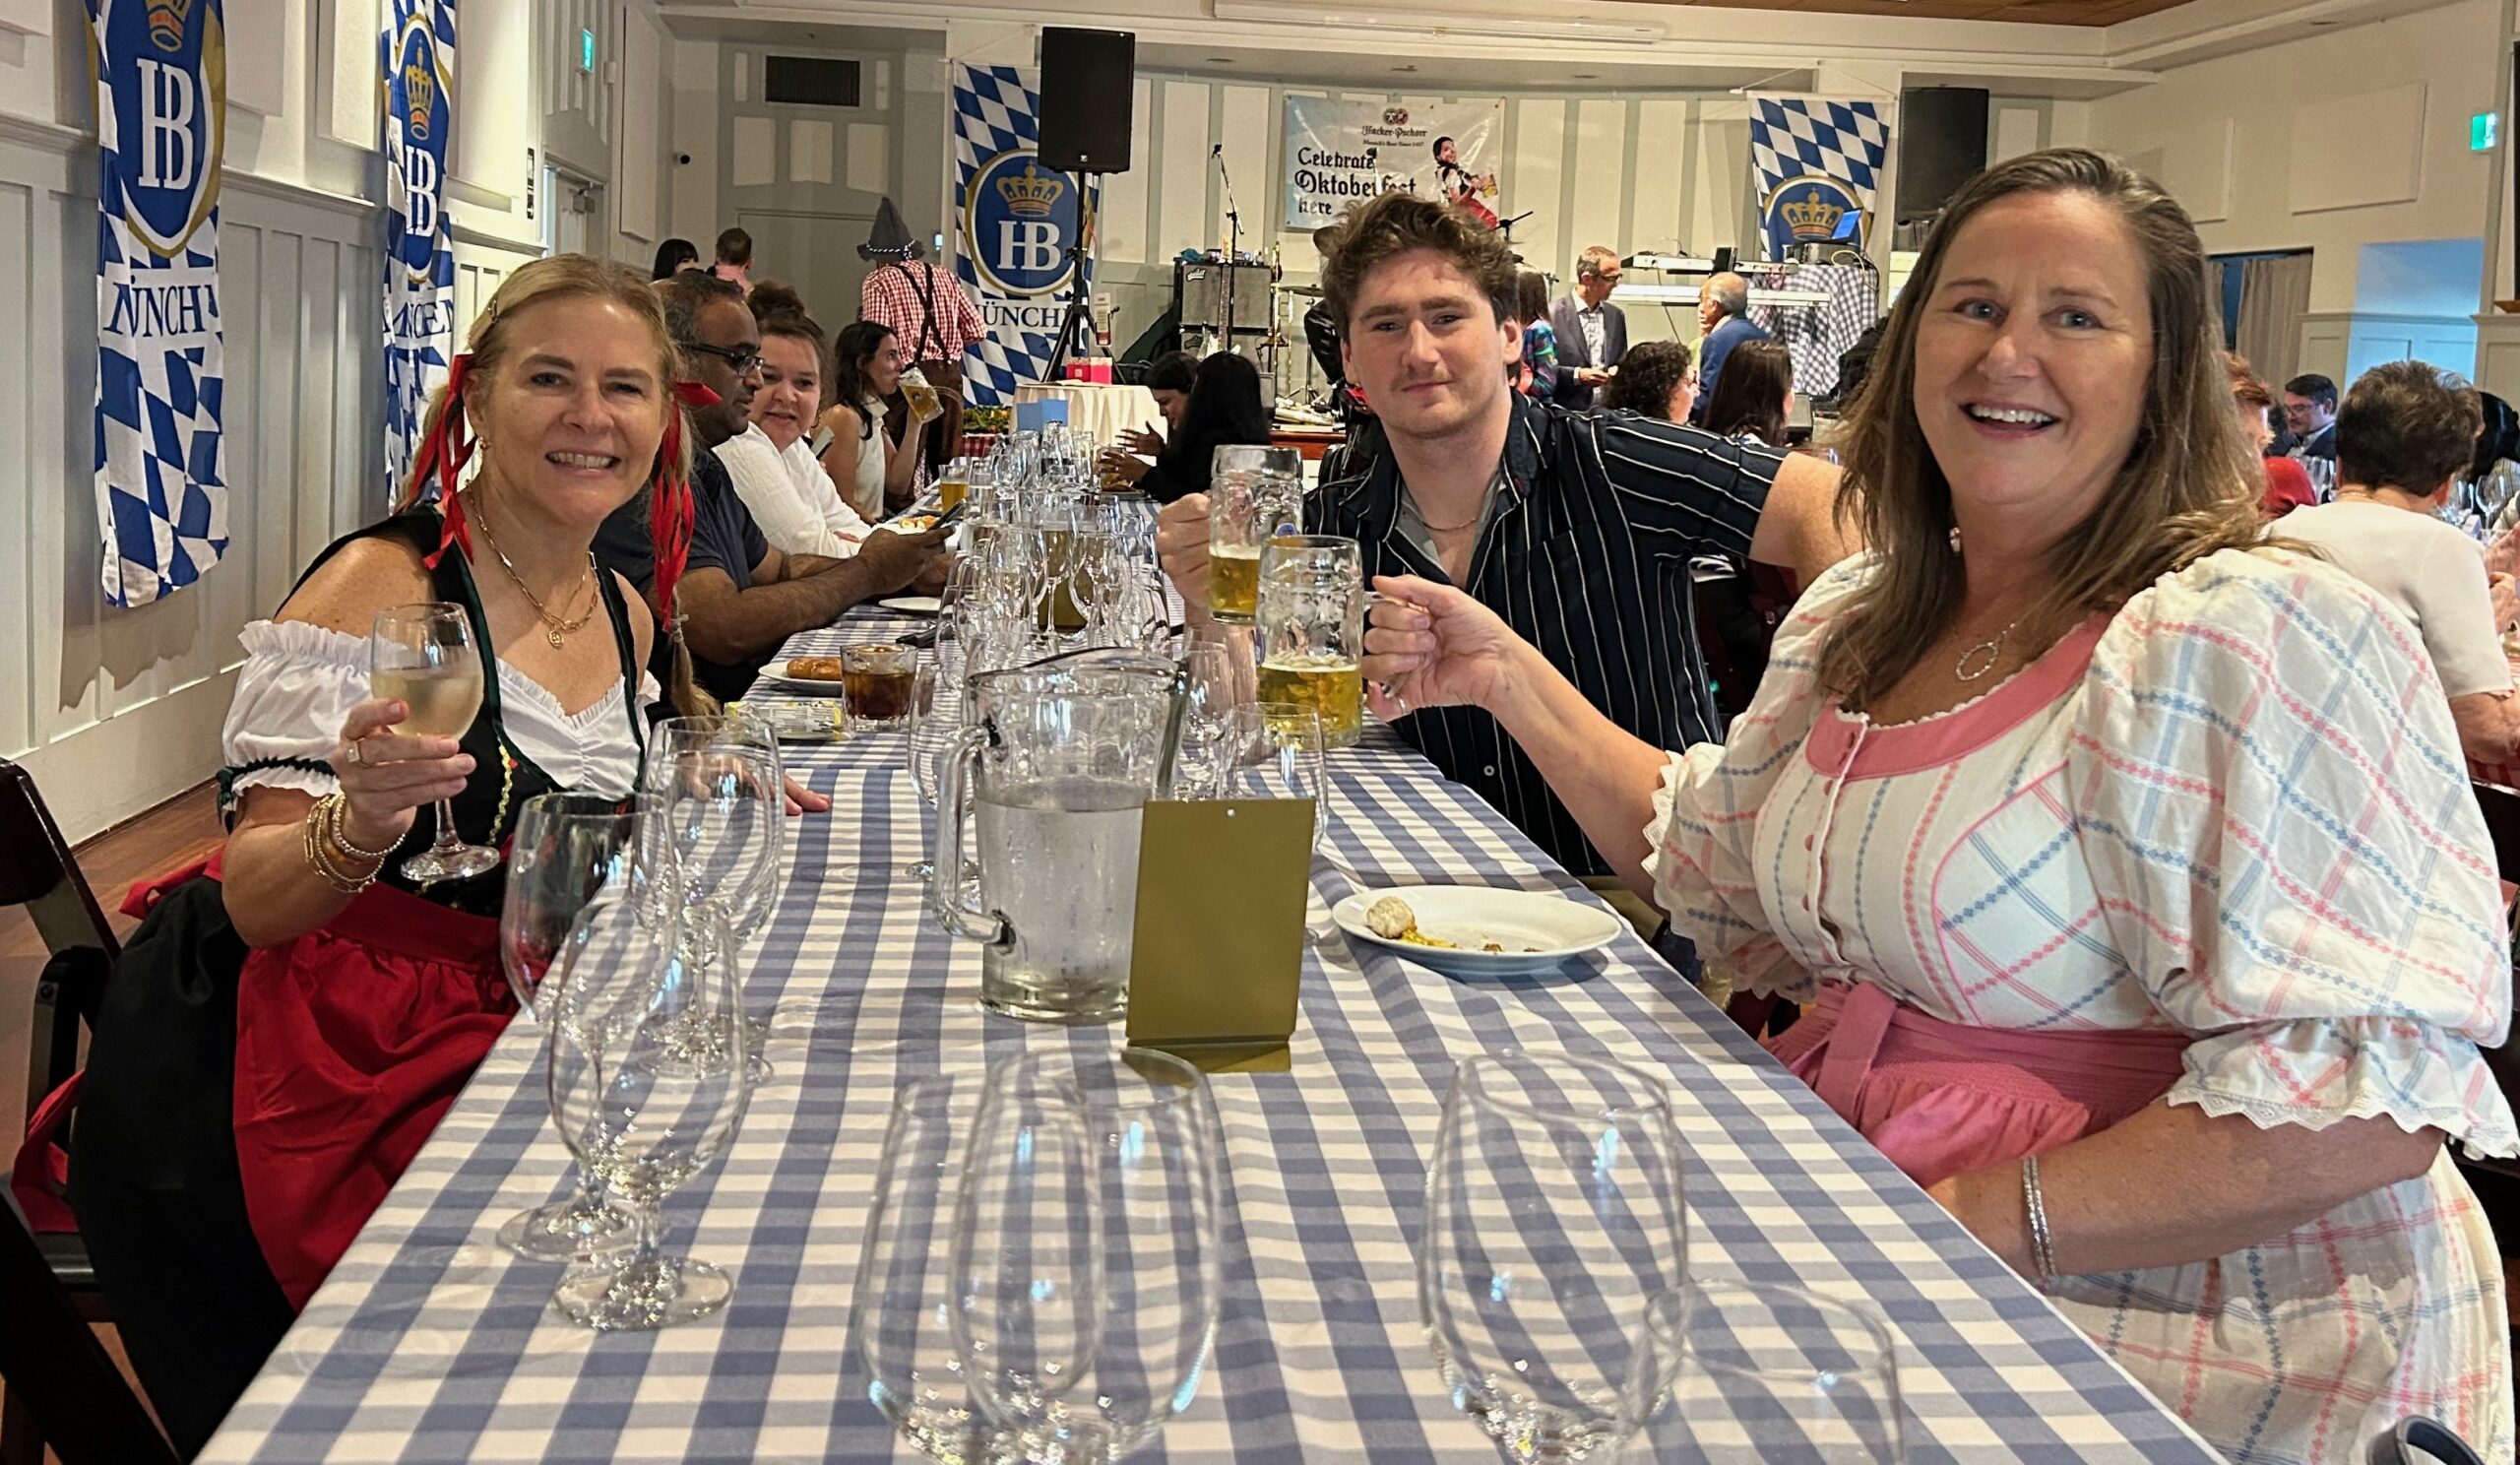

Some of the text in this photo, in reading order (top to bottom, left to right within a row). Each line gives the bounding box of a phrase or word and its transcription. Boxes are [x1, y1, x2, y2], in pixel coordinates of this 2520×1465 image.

[136, 57, 194, 190] HB
[1361, 125, 1427, 139] Hacker-Pschorr
[1297, 147, 1374, 169] Celebrate
[405, 144, 438, 237] HB
[1294, 169, 1417, 197] Oktoberft
[1298, 197, 1332, 215] here
[997, 220, 1061, 271] HB
